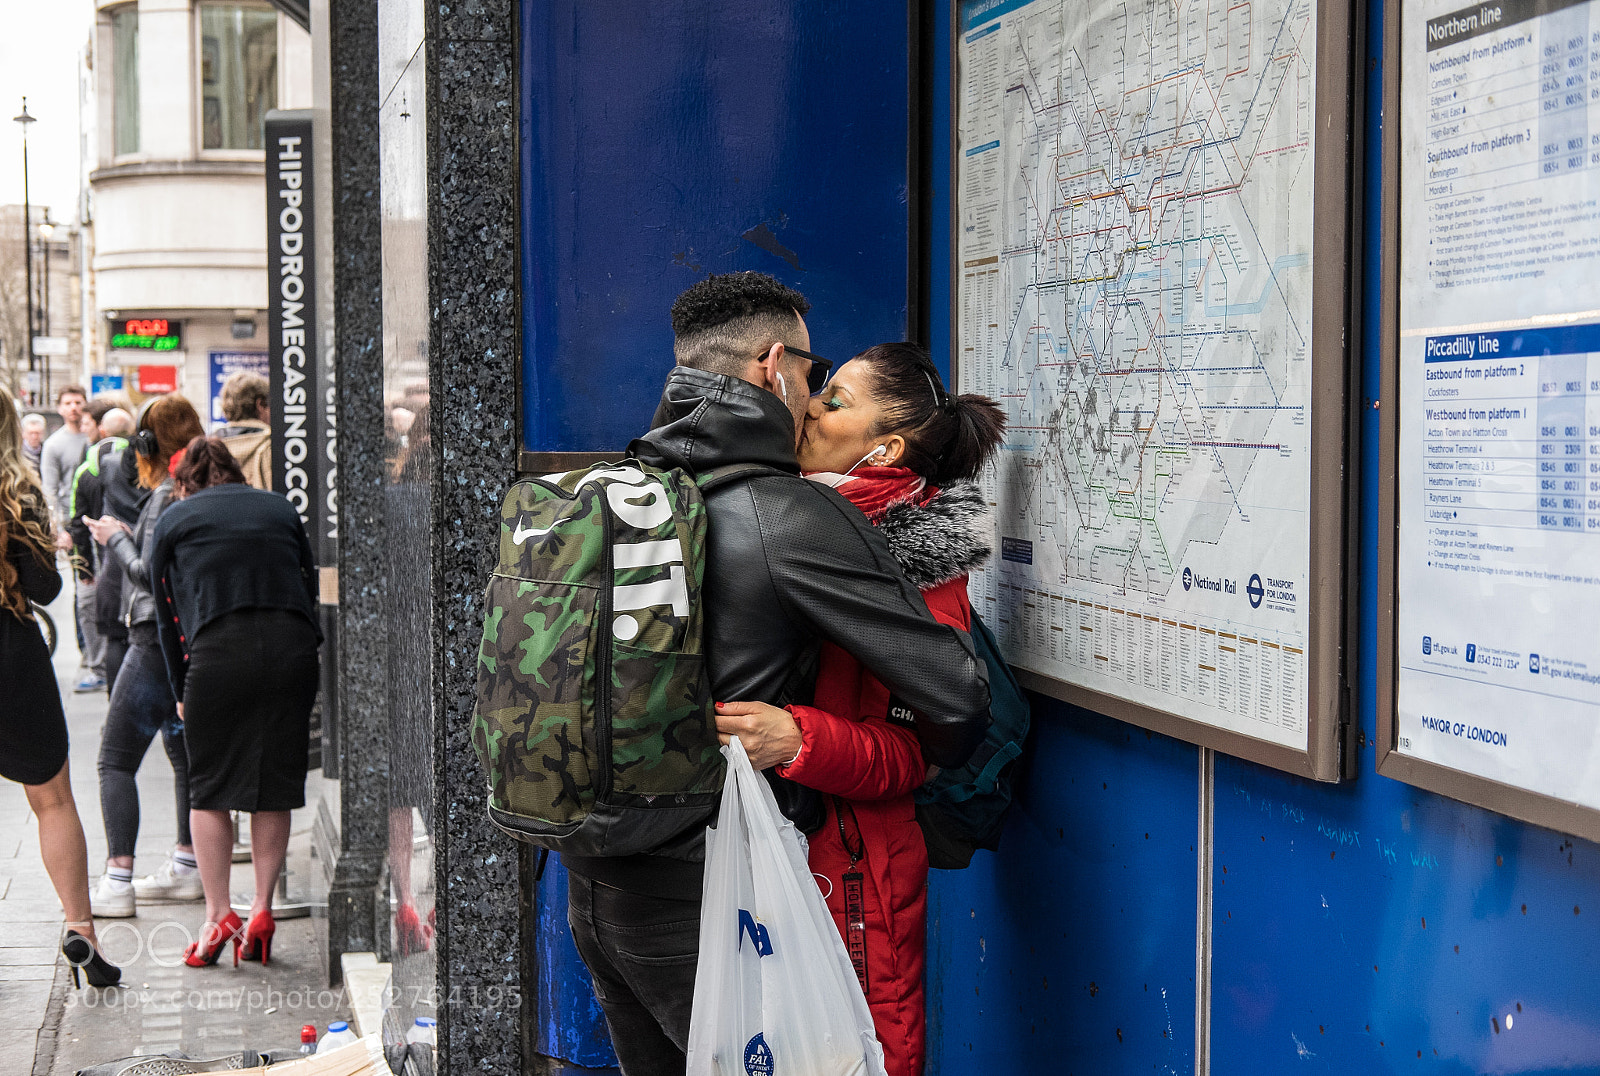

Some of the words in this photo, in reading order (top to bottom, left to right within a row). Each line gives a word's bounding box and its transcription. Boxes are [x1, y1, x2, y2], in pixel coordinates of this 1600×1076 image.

[1428, 14, 1478, 43] Northern
[1480, 6, 1502, 26] line
[1429, 50, 1471, 74] Northbound
[1472, 47, 1490, 60] from
[1492, 37, 1526, 57] platform
[1527, 33, 1533, 43] 4
[1431, 77, 1452, 90] Camden
[1452, 72, 1468, 83] Town
[1427, 143, 1469, 163] Southbound
[1470, 141, 1489, 154] from
[1491, 133, 1524, 152] platform
[1526, 128, 1531, 141] 3
[1429, 167, 1459, 180] Kennington
[1428, 184, 1449, 196] Morden
[278, 136, 309, 538] HIPPODROMECASINO.CO
[1427, 336, 1476, 358] Piccadilly
[1478, 335, 1500, 354] line
[1426, 367, 1462, 381] Eastbound
[1464, 366, 1483, 379] from
[1484, 365, 1517, 381] platform
[1519, 364, 1525, 376] 2
[1427, 387, 1460, 397] Cockfosters
[1425, 408, 1467, 421] Westbound
[1468, 408, 1487, 420] from
[1488, 407, 1521, 422] platform
[1427, 428, 1444, 438] Acton
[1444, 427, 1462, 437] Town
[1462, 428, 1472, 437] and
[1472, 427, 1492, 437] Hatton
[1492, 427, 1508, 437] Cross
[1427, 444, 1454, 454] Heathrow
[1455, 444, 1478, 454] Terminal
[1427, 460, 1454, 471] Heathrow
[1455, 460, 1480, 471] Terminals
[1428, 477, 1455, 487] Heathrow
[1456, 477, 1477, 488] Terminal
[1429, 493, 1449, 505] Rayners
[1449, 493, 1462, 504] Lane
[1429, 509, 1452, 521] Uxbridge
[612, 538, 690, 641] IT.
[1193, 573, 1222, 593] National
[1224, 578, 1237, 595] Rail
[1266, 577, 1294, 590] TRANSPORT
[1266, 589, 1276, 599] FOR
[1276, 591, 1297, 602] LONDON
[1433, 642, 1458, 655] tfl.gov.uk
[1476, 653, 1491, 666] 0343
[1492, 656, 1502, 668] 222
[1421, 715, 1451, 735] MAYOR
[1452, 722, 1466, 738] OF
[1466, 725, 1508, 747] LONDON
